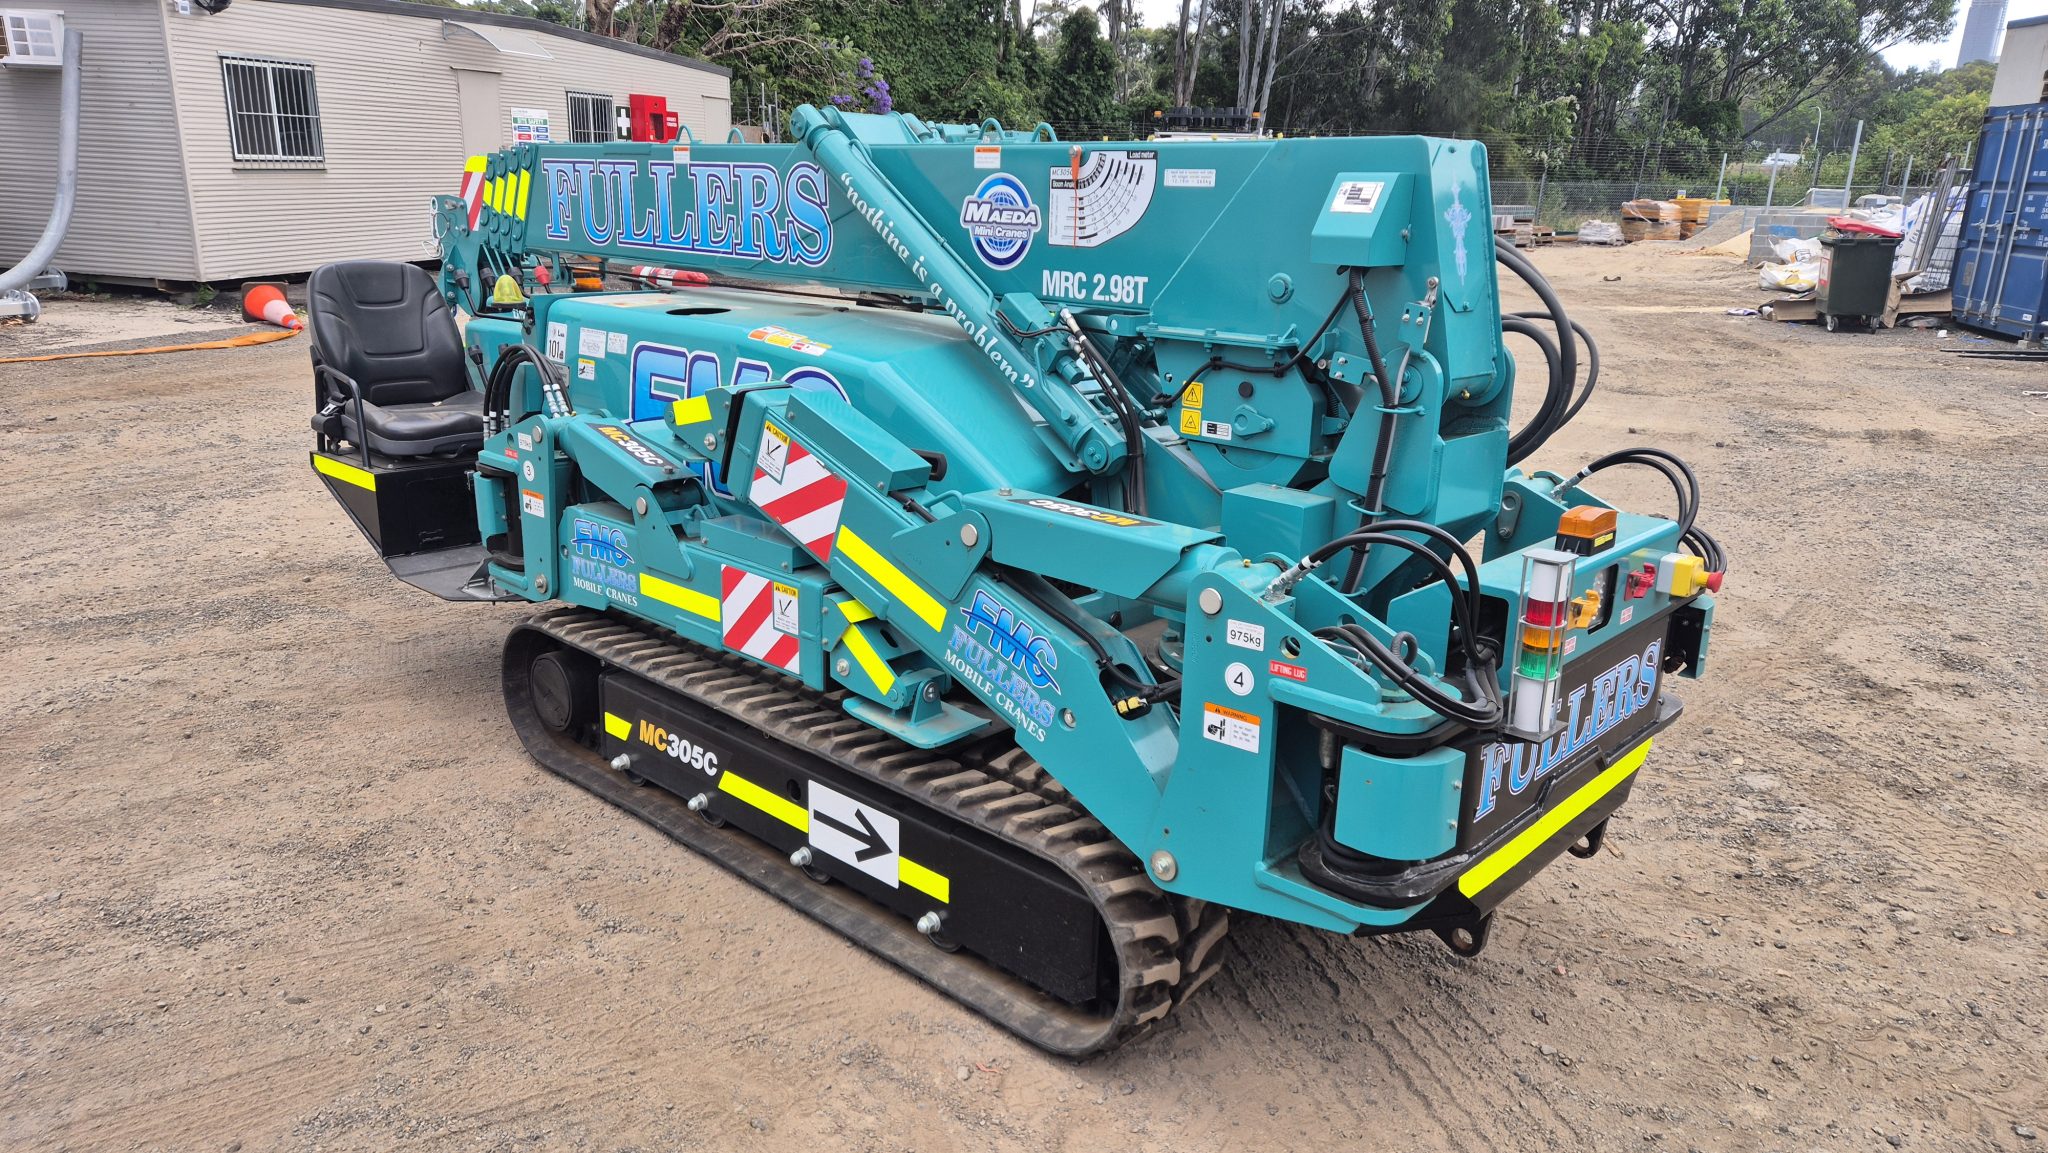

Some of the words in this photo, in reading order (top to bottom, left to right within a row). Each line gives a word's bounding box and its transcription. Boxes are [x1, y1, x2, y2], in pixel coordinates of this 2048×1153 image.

[1129, 151, 1141, 159] Load
[1141, 151, 1155, 159] meter
[1052, 179, 1064, 188] Boom
[541, 158, 834, 267] FULLERS
[963, 201, 1038, 227] MAEDA
[974, 225, 994, 237] Mini
[995, 226, 1028, 239] Cranes
[912, 254, 928, 283] is
[930, 282, 943, 298] a
[1042, 269, 1087, 300] MRC
[1092, 273, 1149, 304] 2.98T
[597, 426, 664, 465] MC305C
[1028, 499, 1141, 526] MC305C
[571, 518, 634, 568] FMC
[571, 555, 638, 593] FULLERS
[573, 576, 603, 596] MOBILE
[605, 587, 638, 607] CRANES
[960, 589, 1061, 695] FMC
[1230, 629, 1261, 648] 975kg
[948, 624, 1056, 727] FULLERS
[1233, 671, 1244, 688] 4
[1270, 663, 1292, 676] LIFTING
[1293, 668, 1305, 679] LUG
[944, 648, 994, 697] MOBILE
[995, 691, 1047, 743] CRANES
[1223, 709, 1249, 721] WARNING
[1473, 638, 1662, 823] FULLERS
[639, 719, 718, 777] MC305C
